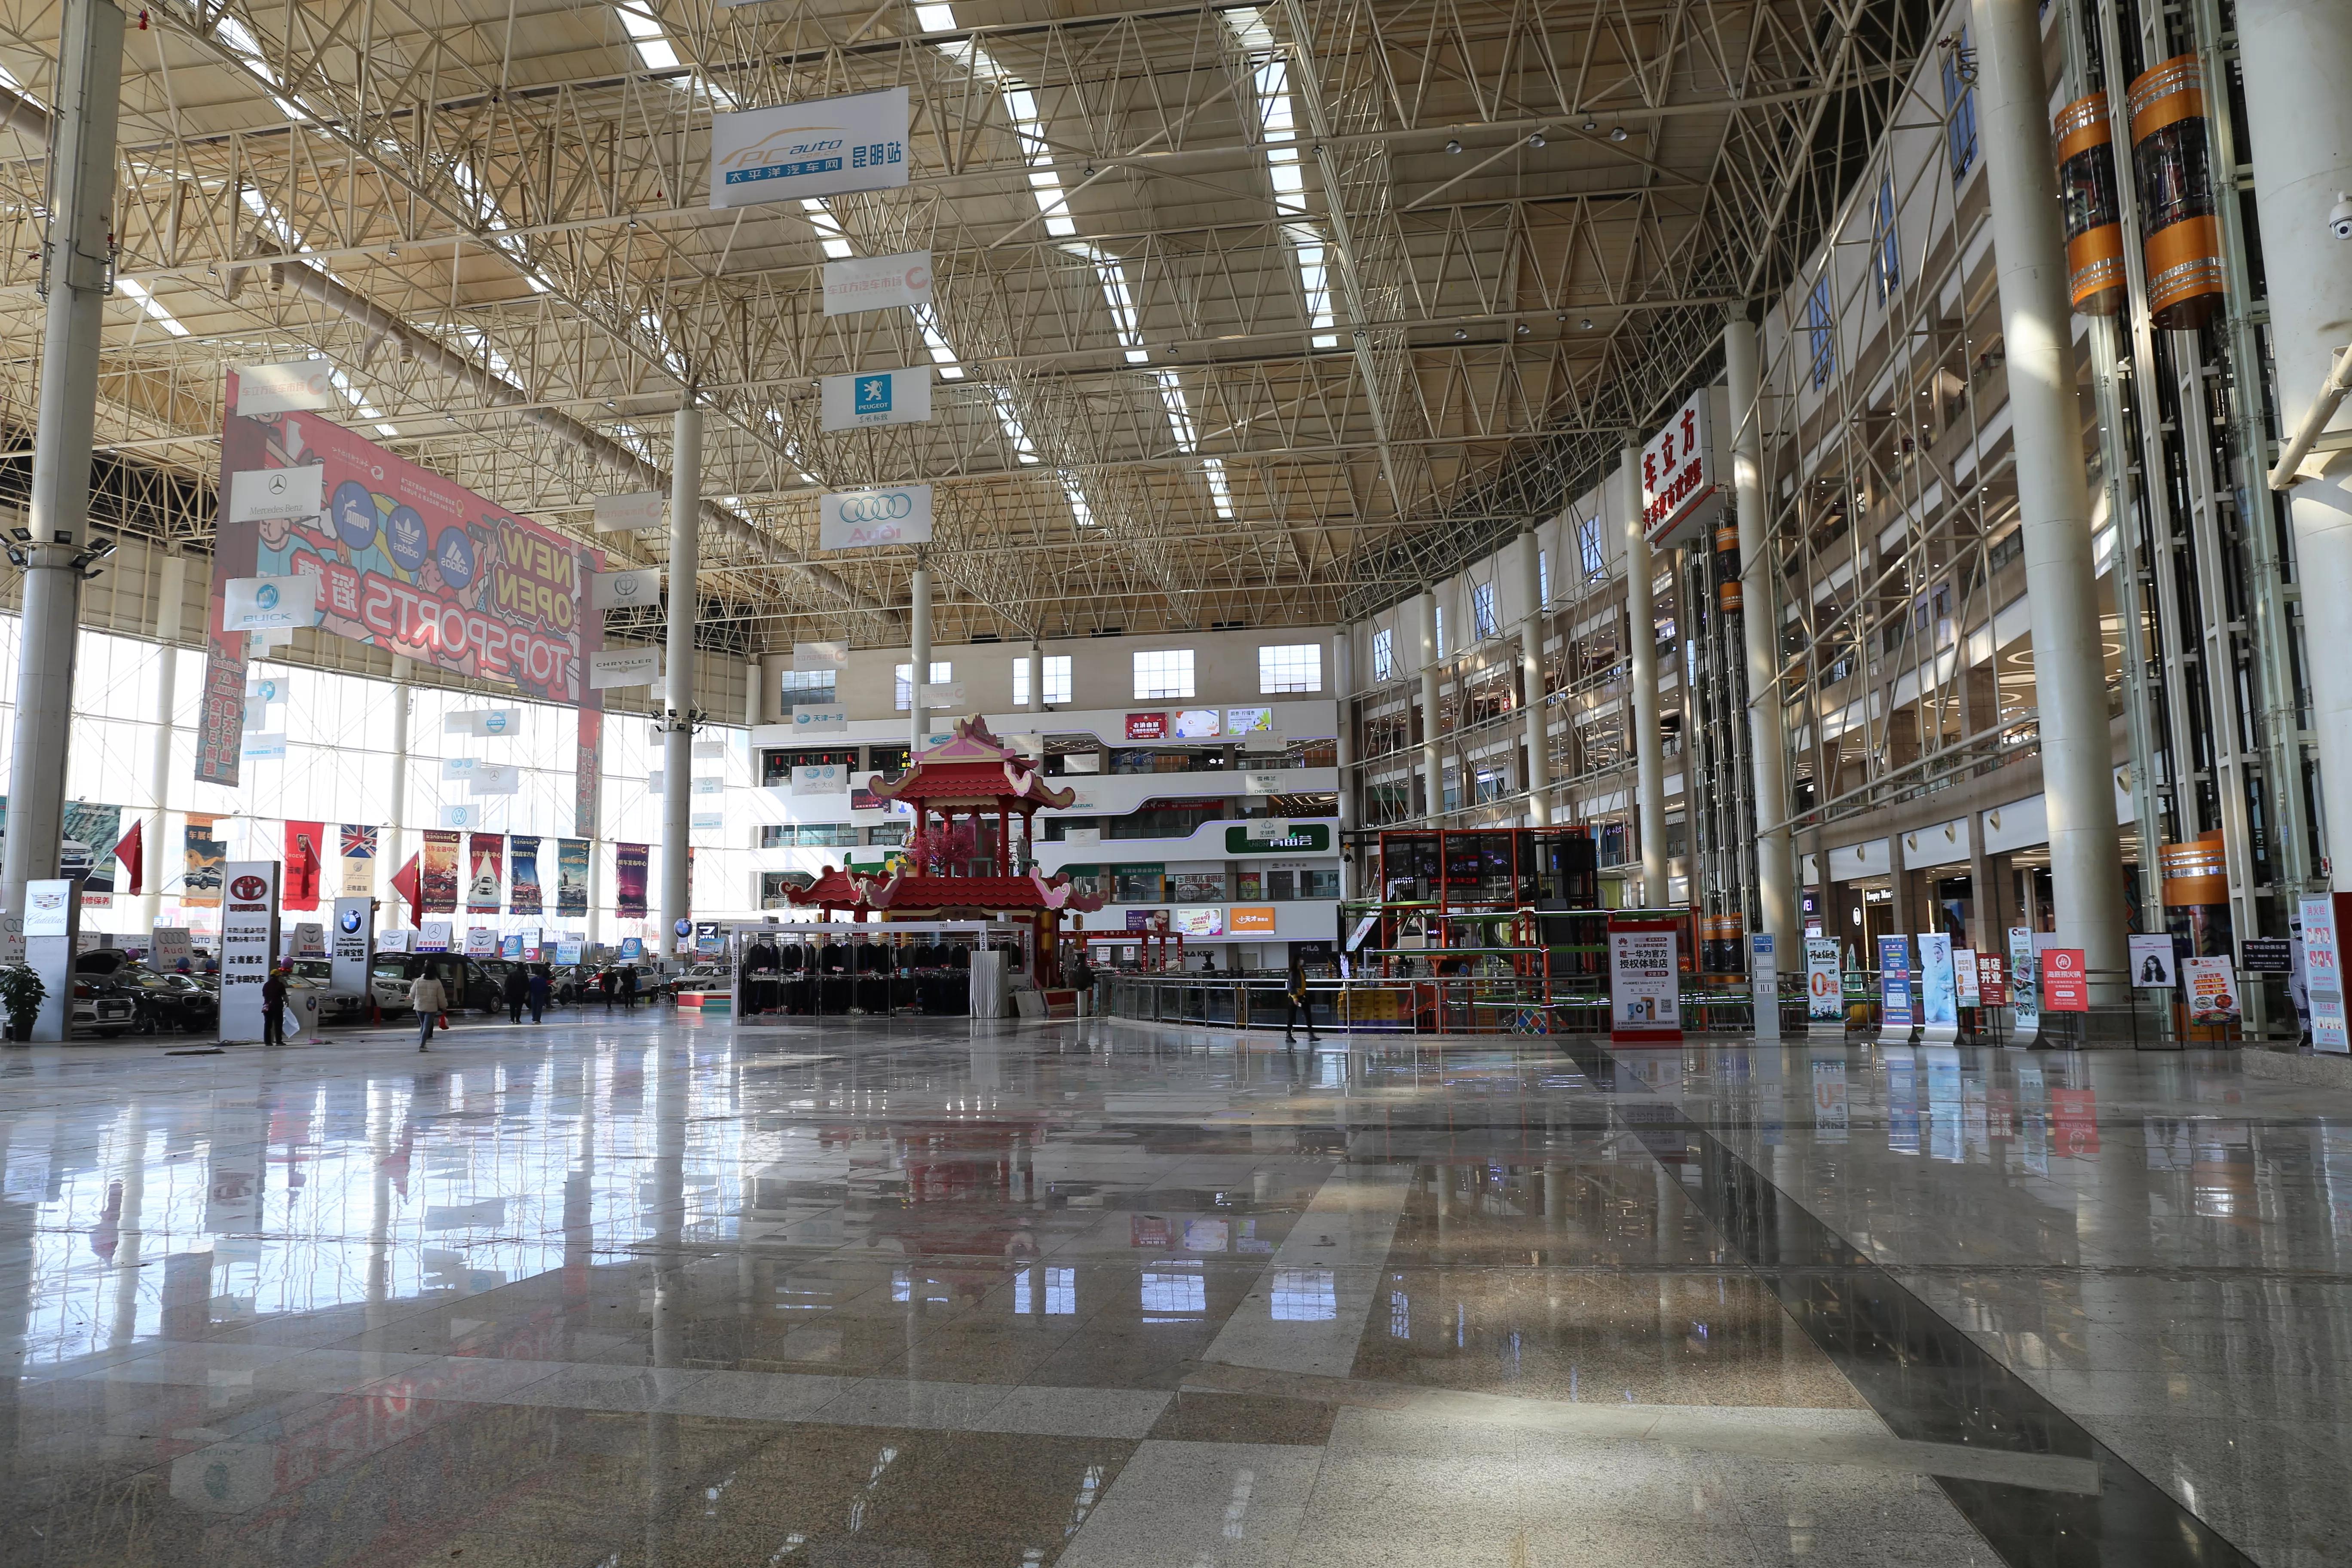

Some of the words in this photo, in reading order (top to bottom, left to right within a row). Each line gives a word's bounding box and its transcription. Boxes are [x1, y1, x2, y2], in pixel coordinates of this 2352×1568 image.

[852, 141, 901, 168] 昆明站
[729, 159, 839, 183] 太平洋汽车网
[858, 402, 888, 410] PEUGEOT
[1644, 409, 1695, 493] 车立方
[249, 504, 303, 515] Mercedes-Benz
[848, 525, 901, 543] Audi
[613, 596, 637, 606] 中华
[242, 612, 292, 623] BUICK
[596, 658, 652, 668] CHRYSLER
[813, 714, 844, 722] 天津一汽
[2306, 905, 2326, 916] 消火栓
[26, 912, 66, 926] Cadillac
[1620, 949, 1668, 958] 唯一华为官方
[1620, 958, 1668, 969] 授权体验店
[1979, 958, 2000, 971] 新店
[235, 975, 265, 983] 丰田汽车
[1980, 971, 2002, 984] 开业
